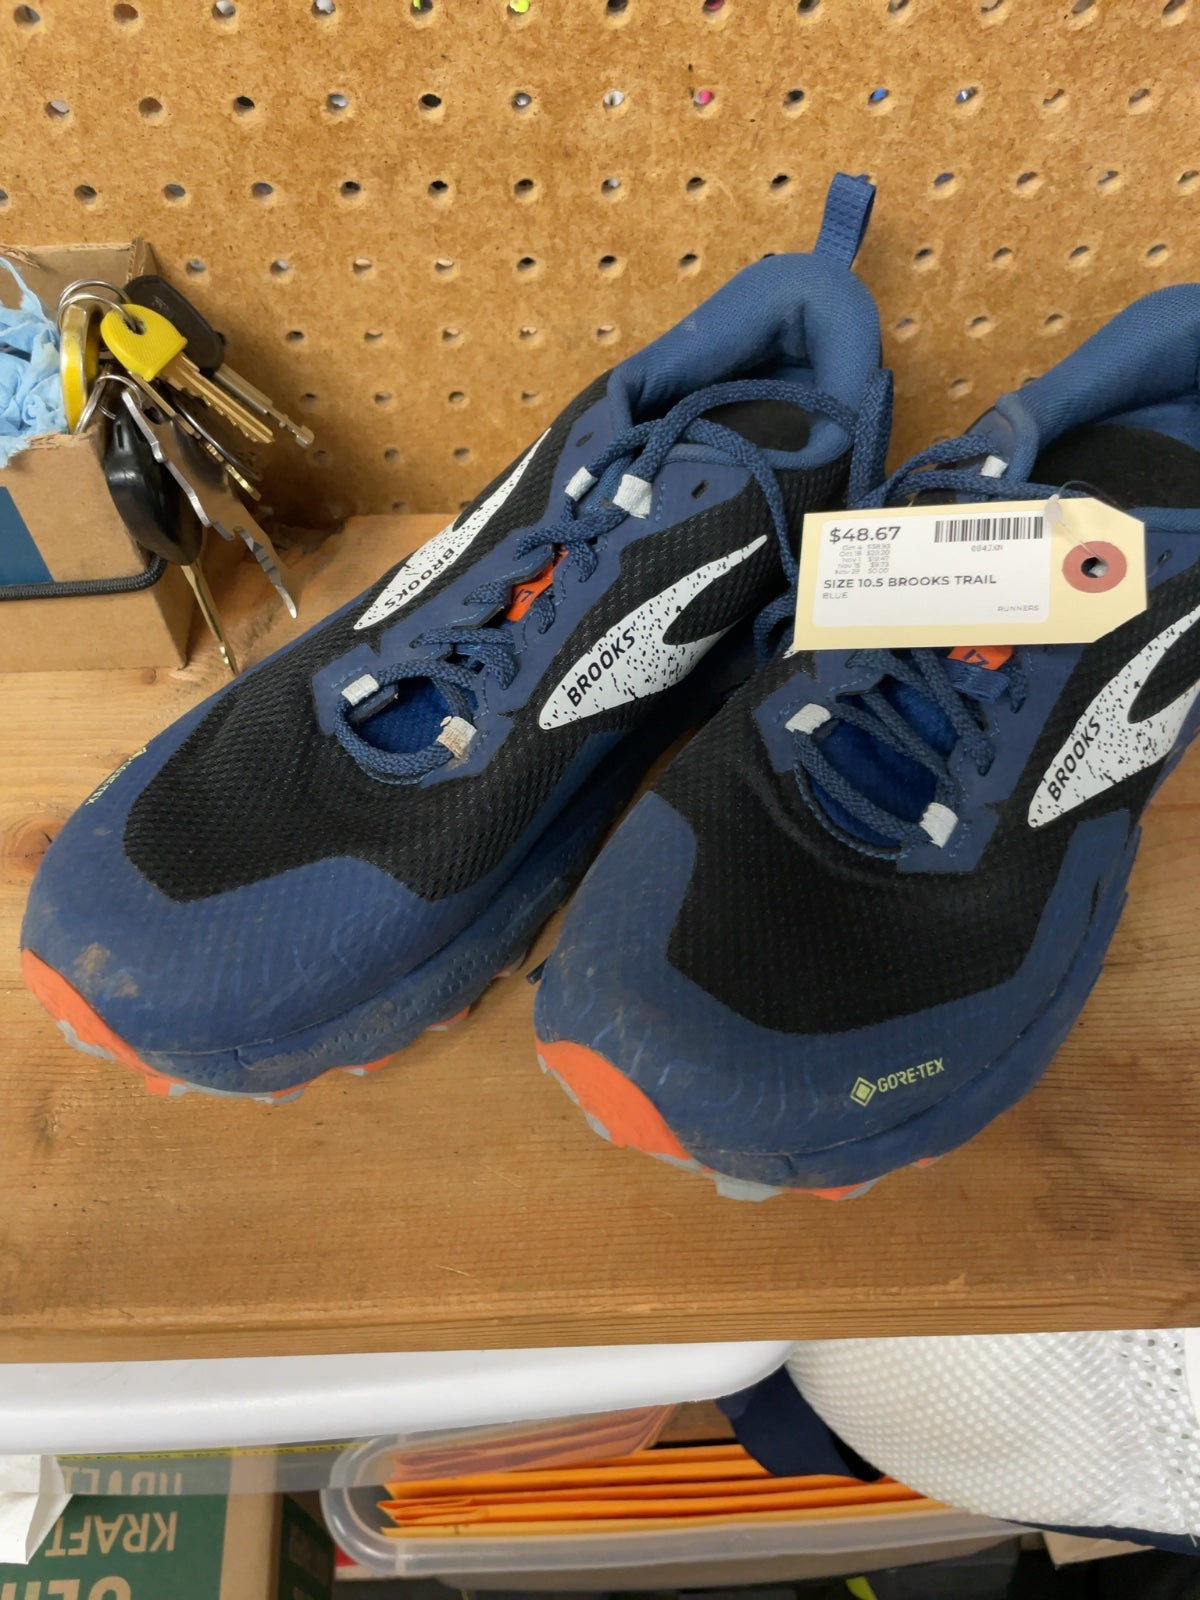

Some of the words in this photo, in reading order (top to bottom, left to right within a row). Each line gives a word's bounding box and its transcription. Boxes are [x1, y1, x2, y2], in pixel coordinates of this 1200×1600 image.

[829, 526, 901, 544] $48.67
[384, 548, 454, 609] BROOKS
[824, 579, 854, 589] SIZE
[858, 578, 884, 587] 10.5
[888, 576, 950, 587] BROOKS
[954, 574, 997, 585] TRAIL
[567, 628, 635, 707] BROOKS
[1047, 716, 1101, 802] BROOKS
[877, 1057, 945, 1092] GORE-TEX
[45, 1511, 178, 1557] KRAFT
